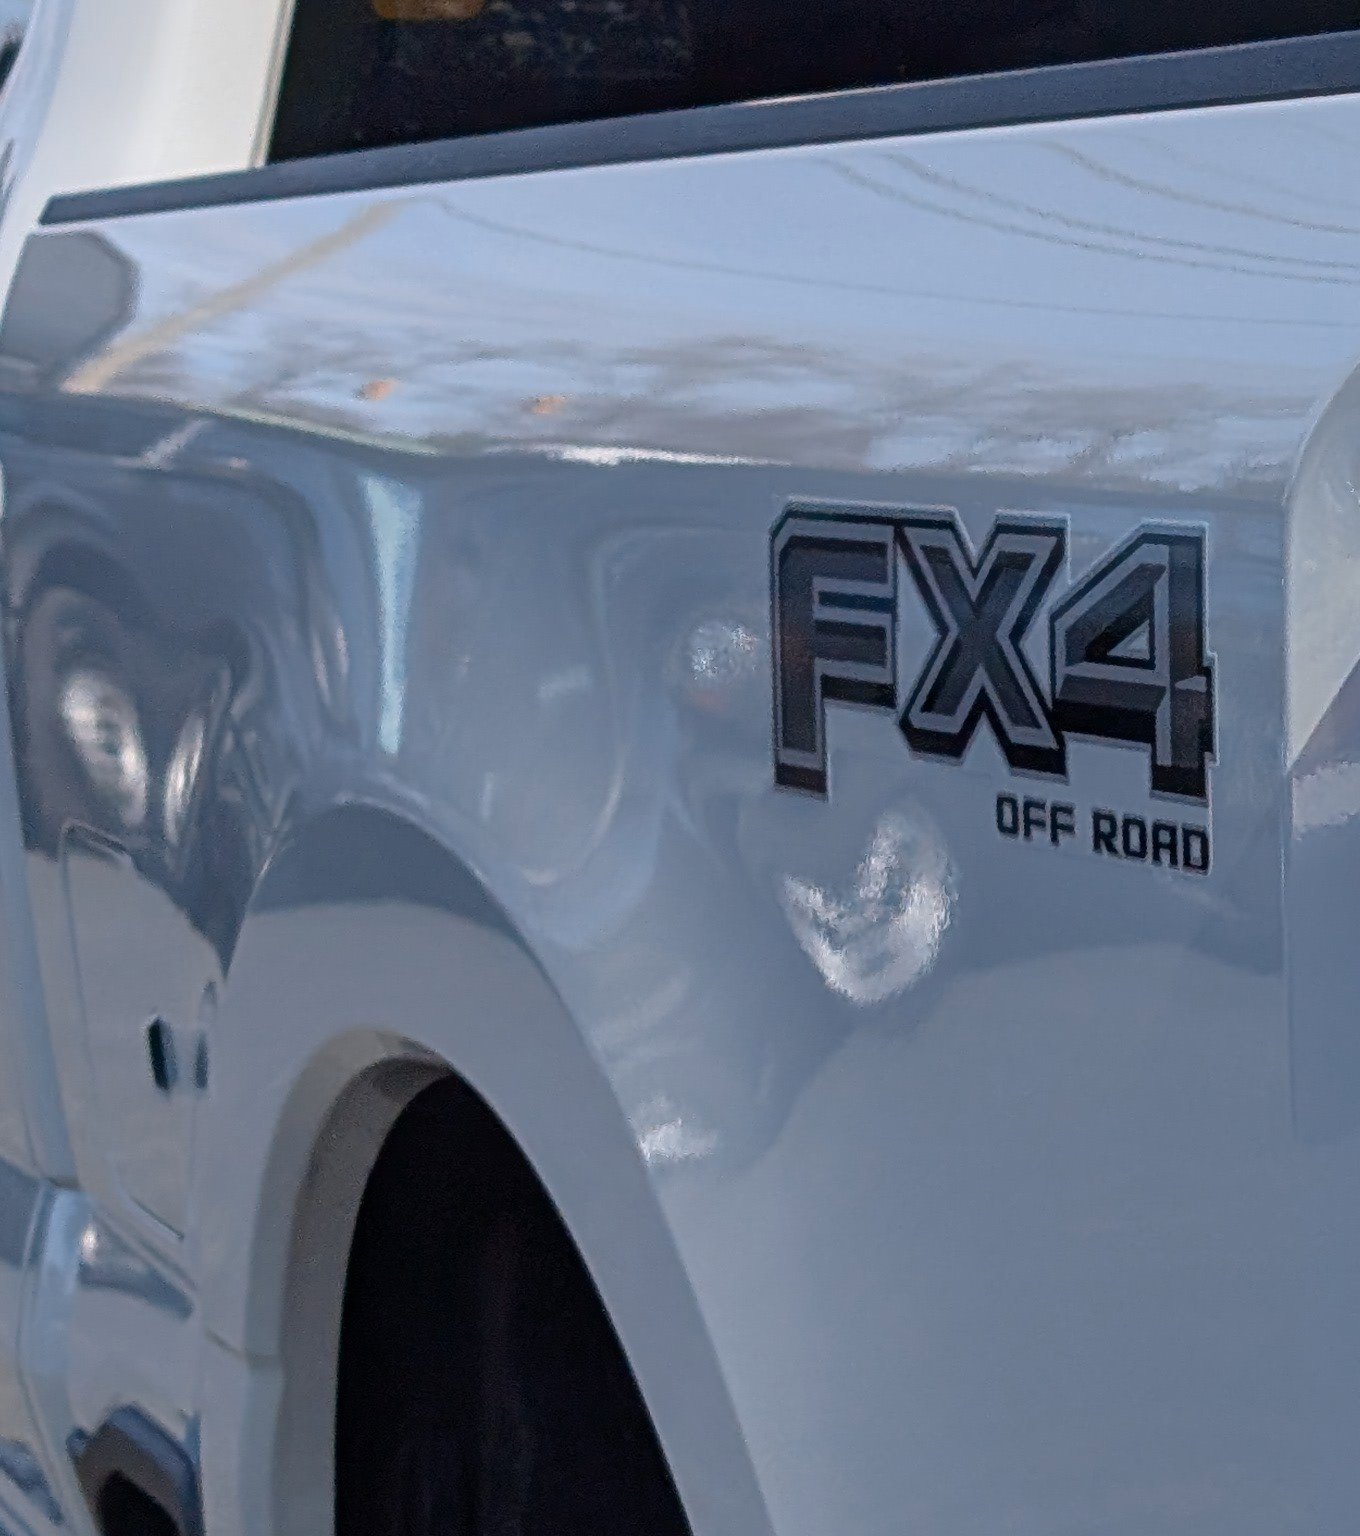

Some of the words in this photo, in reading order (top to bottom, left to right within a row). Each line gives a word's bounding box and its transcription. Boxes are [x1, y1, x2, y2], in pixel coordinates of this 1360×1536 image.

[770, 502, 1216, 802] FX4
[996, 795, 1076, 847] OFF
[1091, 807, 1211, 873] ROAD
